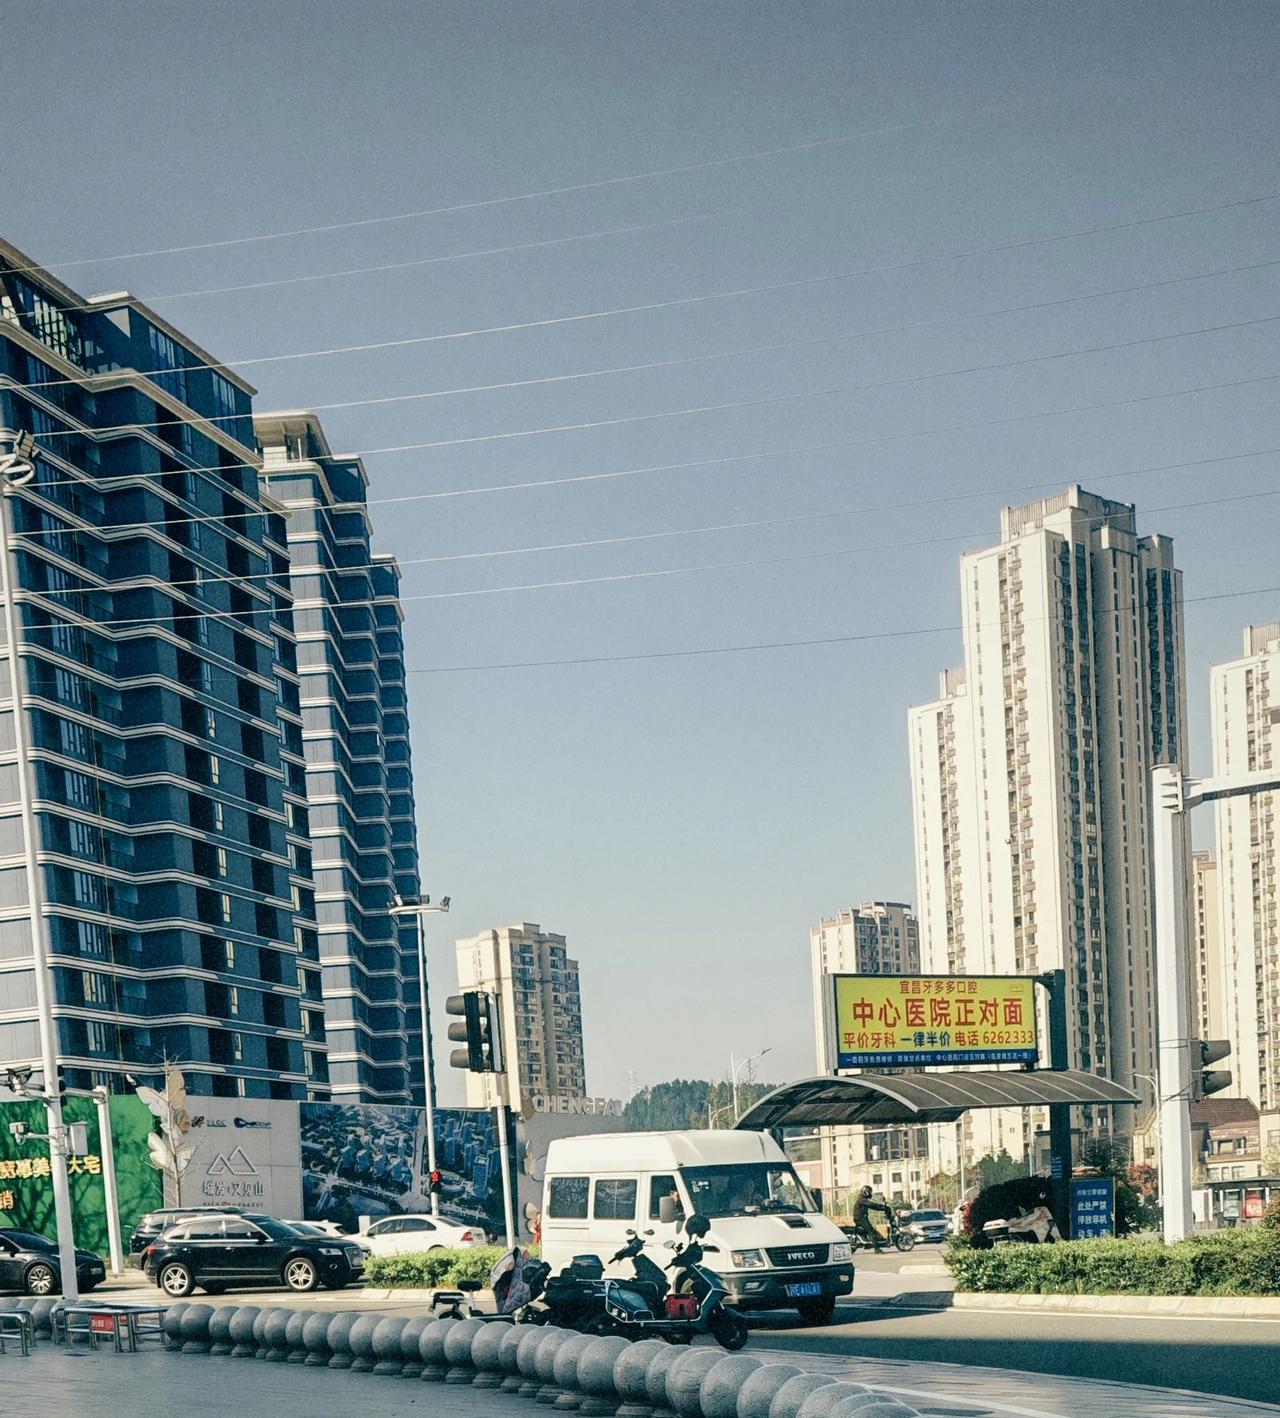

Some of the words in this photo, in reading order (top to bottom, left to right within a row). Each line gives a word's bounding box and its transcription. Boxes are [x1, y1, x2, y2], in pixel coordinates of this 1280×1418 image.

[899, 980, 978, 995] 宜昌牙多多口腔
[852, 996, 1023, 1029] 中心医院正对面
[843, 1032, 897, 1049] 平价牙科
[900, 1031, 951, 1048] 一律半价
[955, 1030, 979, 1047] 电话
[983, 1030, 1034, 1045] 6262333
[1077, 1200, 1107, 1212] 此处严禁
[787, 1251, 815, 1261] IVECO
